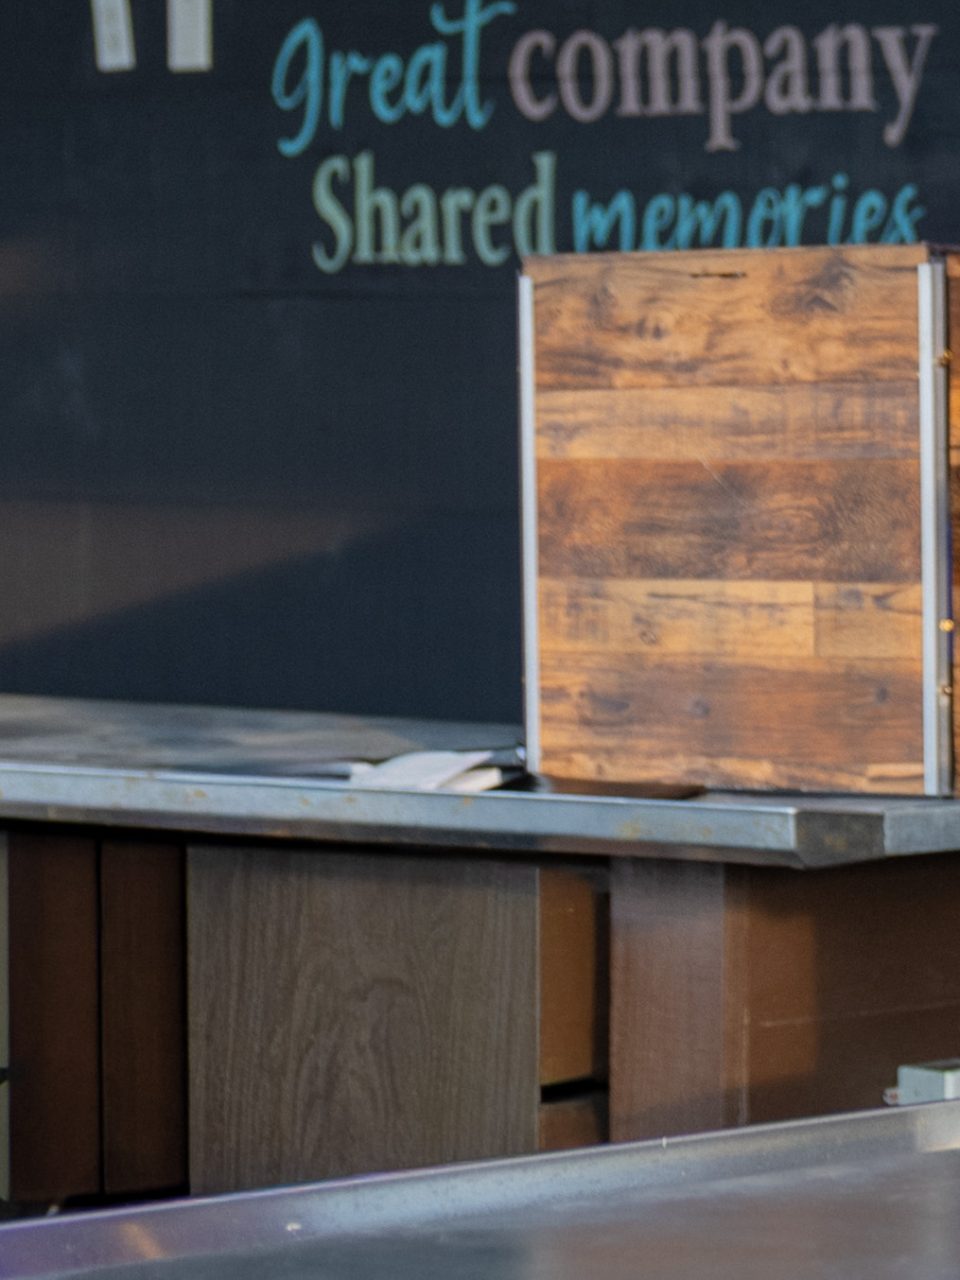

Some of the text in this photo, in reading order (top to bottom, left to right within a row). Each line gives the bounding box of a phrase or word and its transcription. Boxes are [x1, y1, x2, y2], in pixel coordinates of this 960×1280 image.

[508, 20, 938, 152] company
[310, 150, 926, 274] Shared memories
